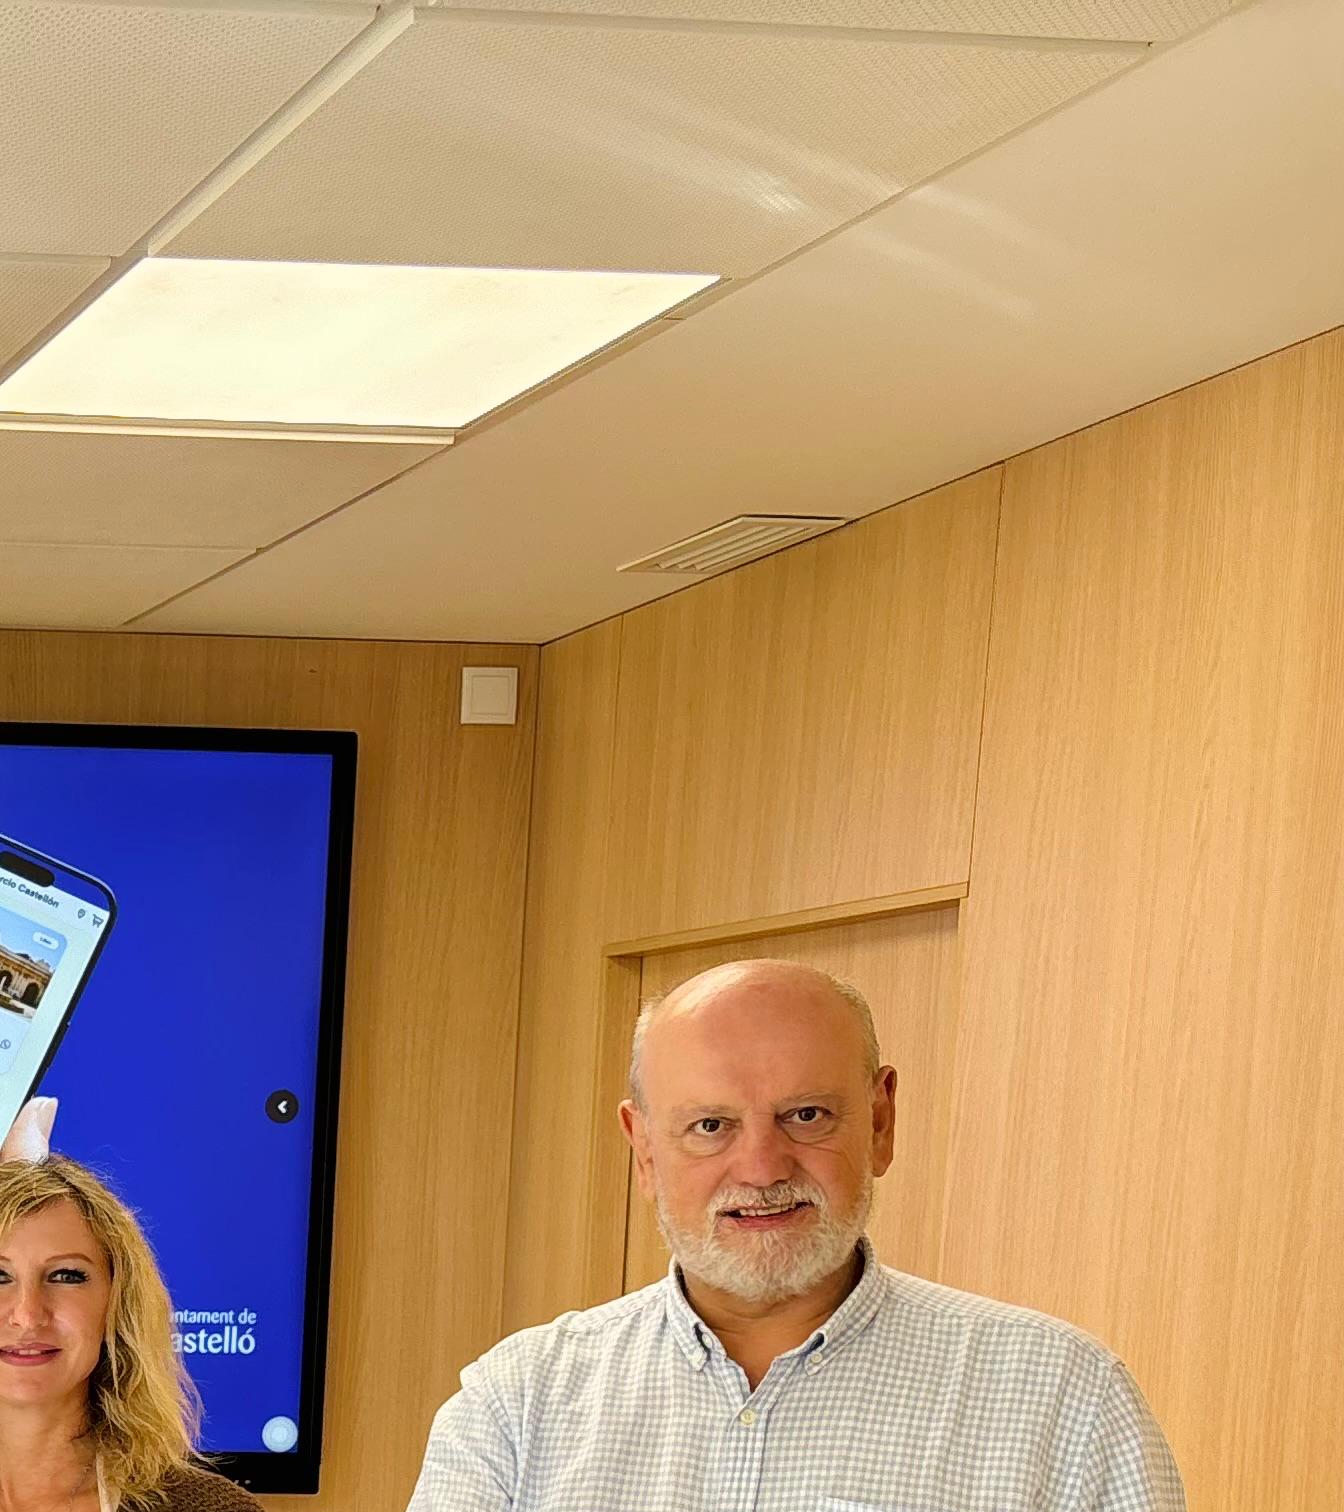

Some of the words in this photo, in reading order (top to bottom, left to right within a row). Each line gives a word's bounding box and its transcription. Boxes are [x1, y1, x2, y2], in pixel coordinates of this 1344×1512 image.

[18, 883, 60, 909] Castellón
[173, 1310, 234, 1325] ntament
[238, 1308, 257, 1325] de
[171, 1326, 257, 1355] astelló
